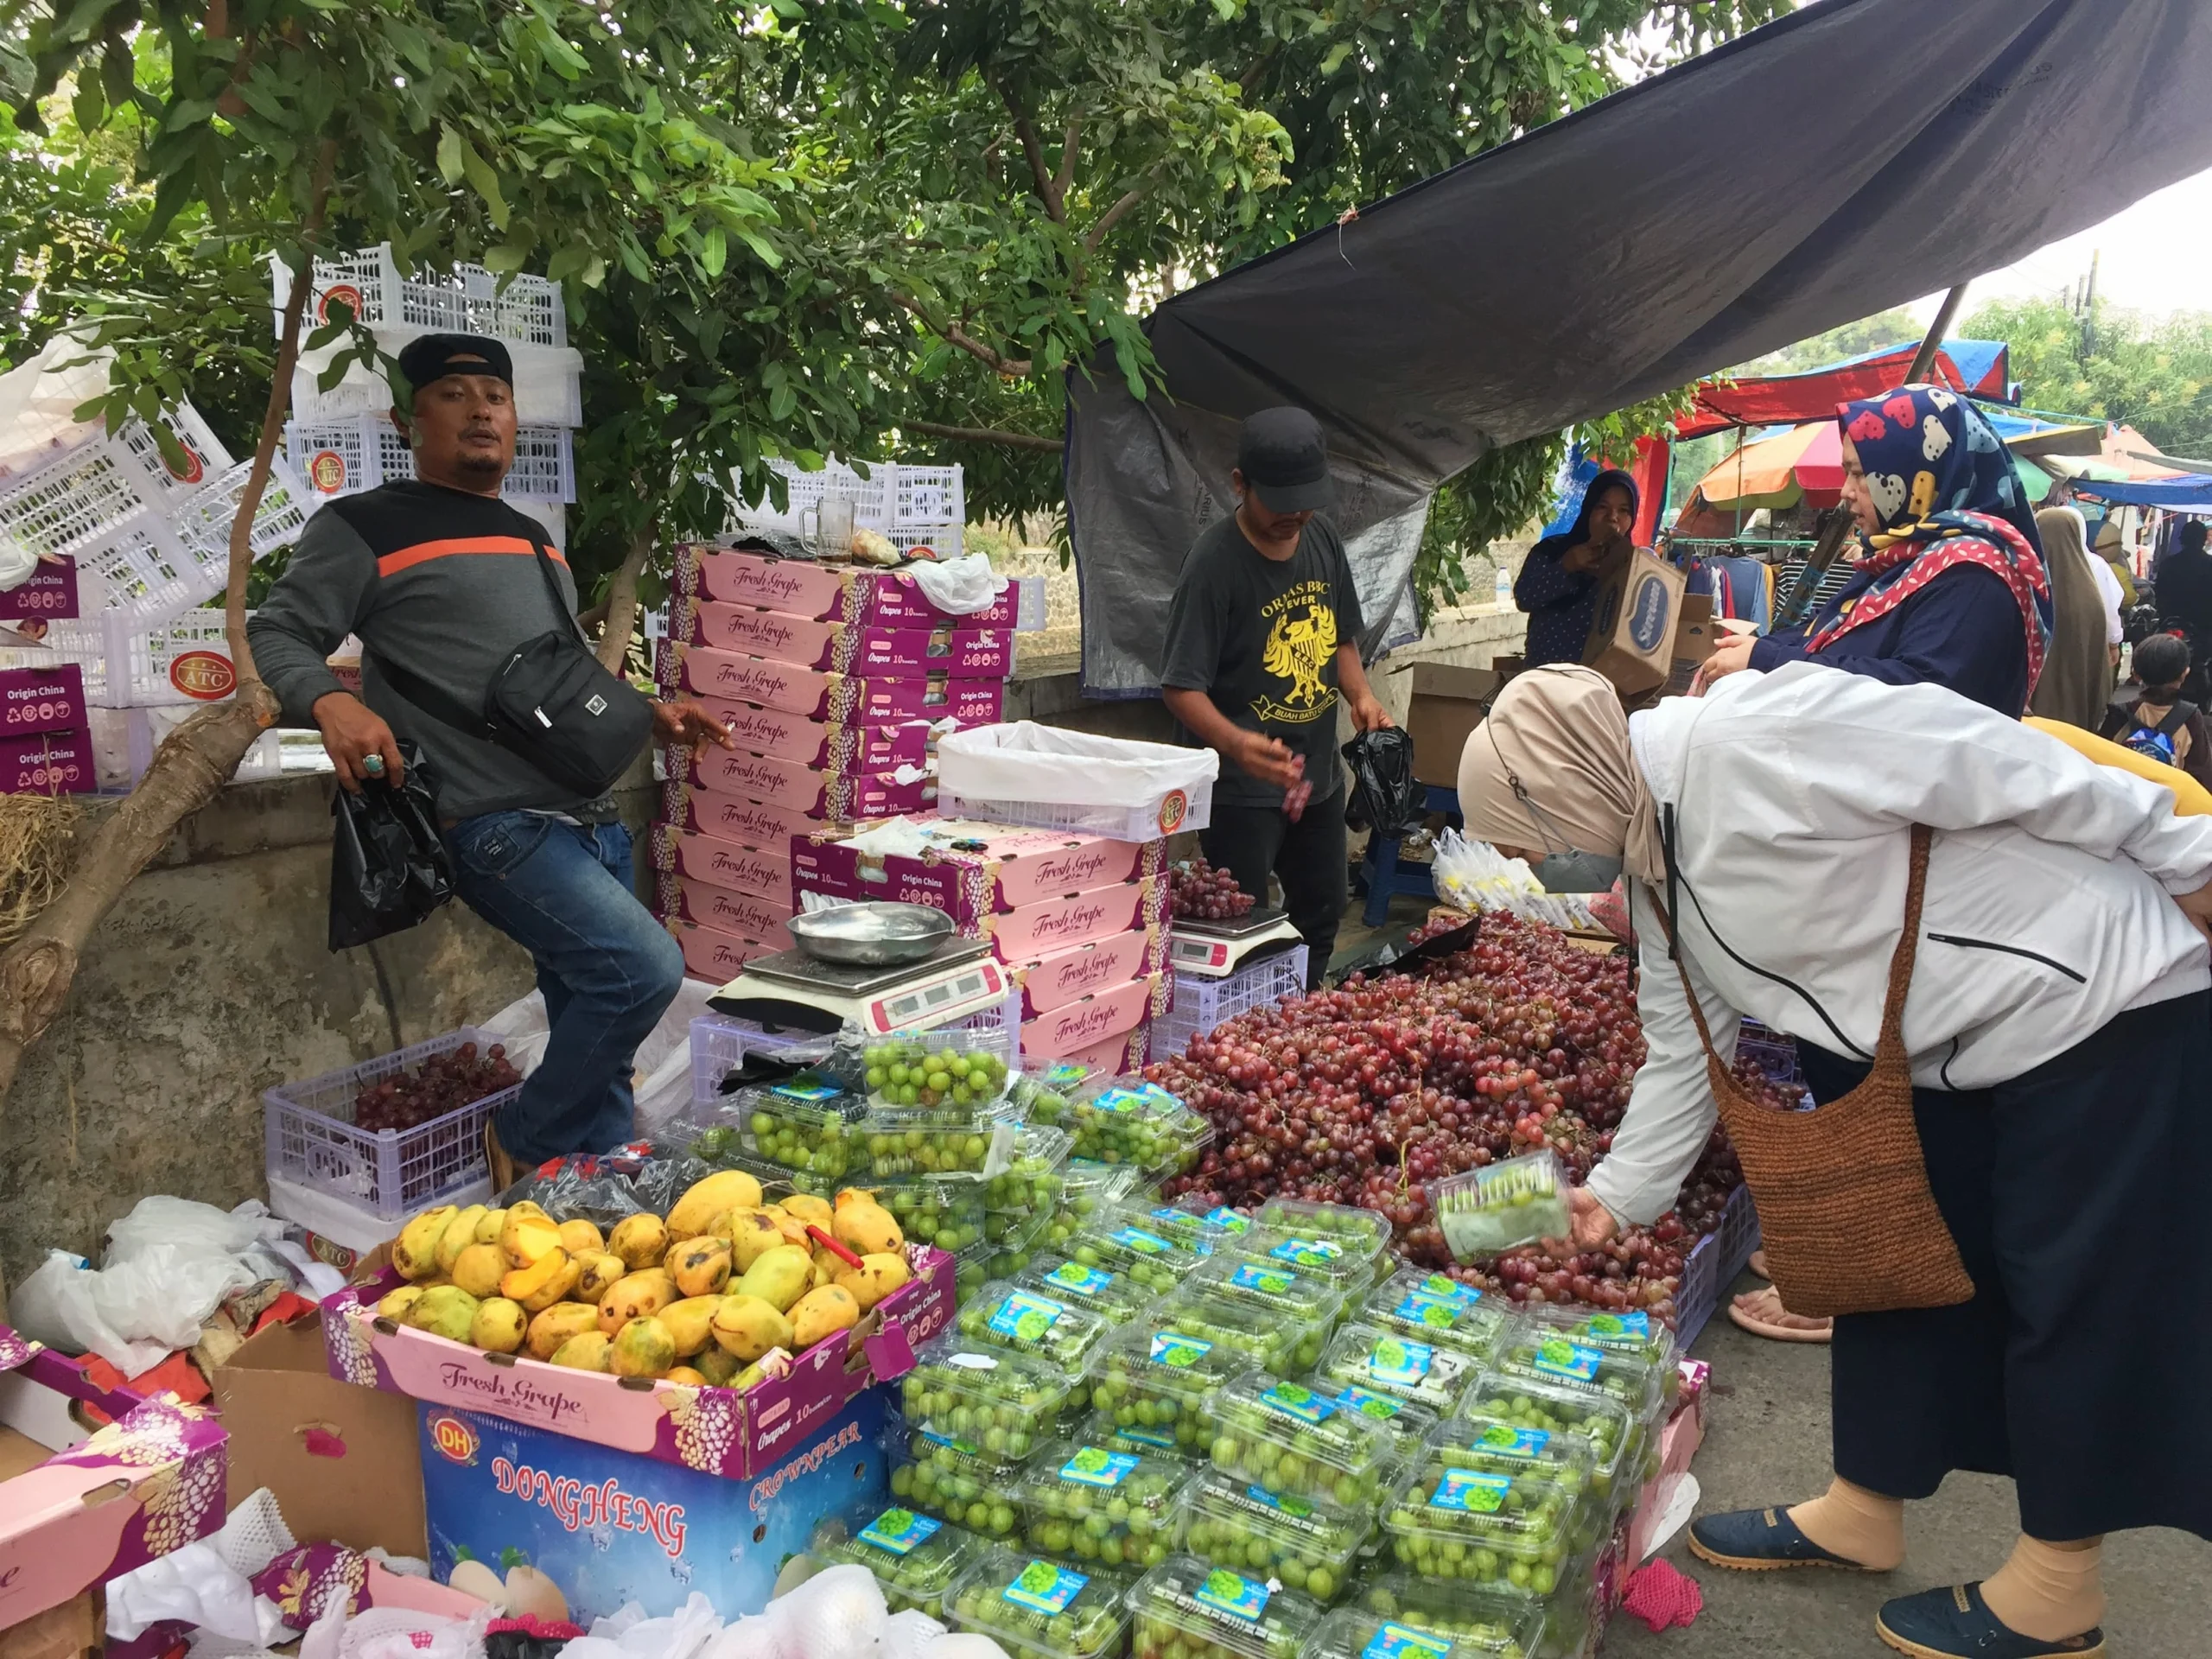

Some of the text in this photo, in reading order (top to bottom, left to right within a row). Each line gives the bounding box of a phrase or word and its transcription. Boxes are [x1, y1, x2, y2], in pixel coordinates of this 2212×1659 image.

[43, 575, 63, 585] China
[734, 567, 804, 599] Fresh Grape
[728, 614, 793, 647] Fresh Grape
[966, 641, 983, 650] Origin
[7, 685, 65, 701] Origin China
[184, 672, 224, 687] ATC
[716, 664, 787, 697] Fresh Grape
[961, 692, 977, 702] Origin
[1274, 709, 1299, 720] BUAH
[754, 718, 788, 745] Grape
[49, 749, 75, 760] China
[722, 758, 788, 791] Fresh Grape
[721, 804, 787, 839] Fresh Grape
[712, 852, 782, 888] Fresh Grape
[902, 874, 943, 888] Origin China
[1035, 854, 1107, 885] Fresh Grape
[713, 896, 777, 932] Fresh Grape
[1033, 906, 1105, 938] Fresh Grape
[1058, 952, 1119, 988] Fresh Grape
[1054, 1005, 1119, 1042] Fresh Grape
[318, 1243, 346, 1265] ATC
[900, 1304, 922, 1325] Origin
[922, 1289, 942, 1308] China
[440, 1363, 505, 1395] Fresh
[511, 1380, 583, 1420] Grape
[441, 1429, 468, 1453] DH
[758, 1418, 791, 1452] Grapes
[749, 1421, 862, 1512] CROWNPEAR
[492, 1457, 688, 1558] DONGHENG
